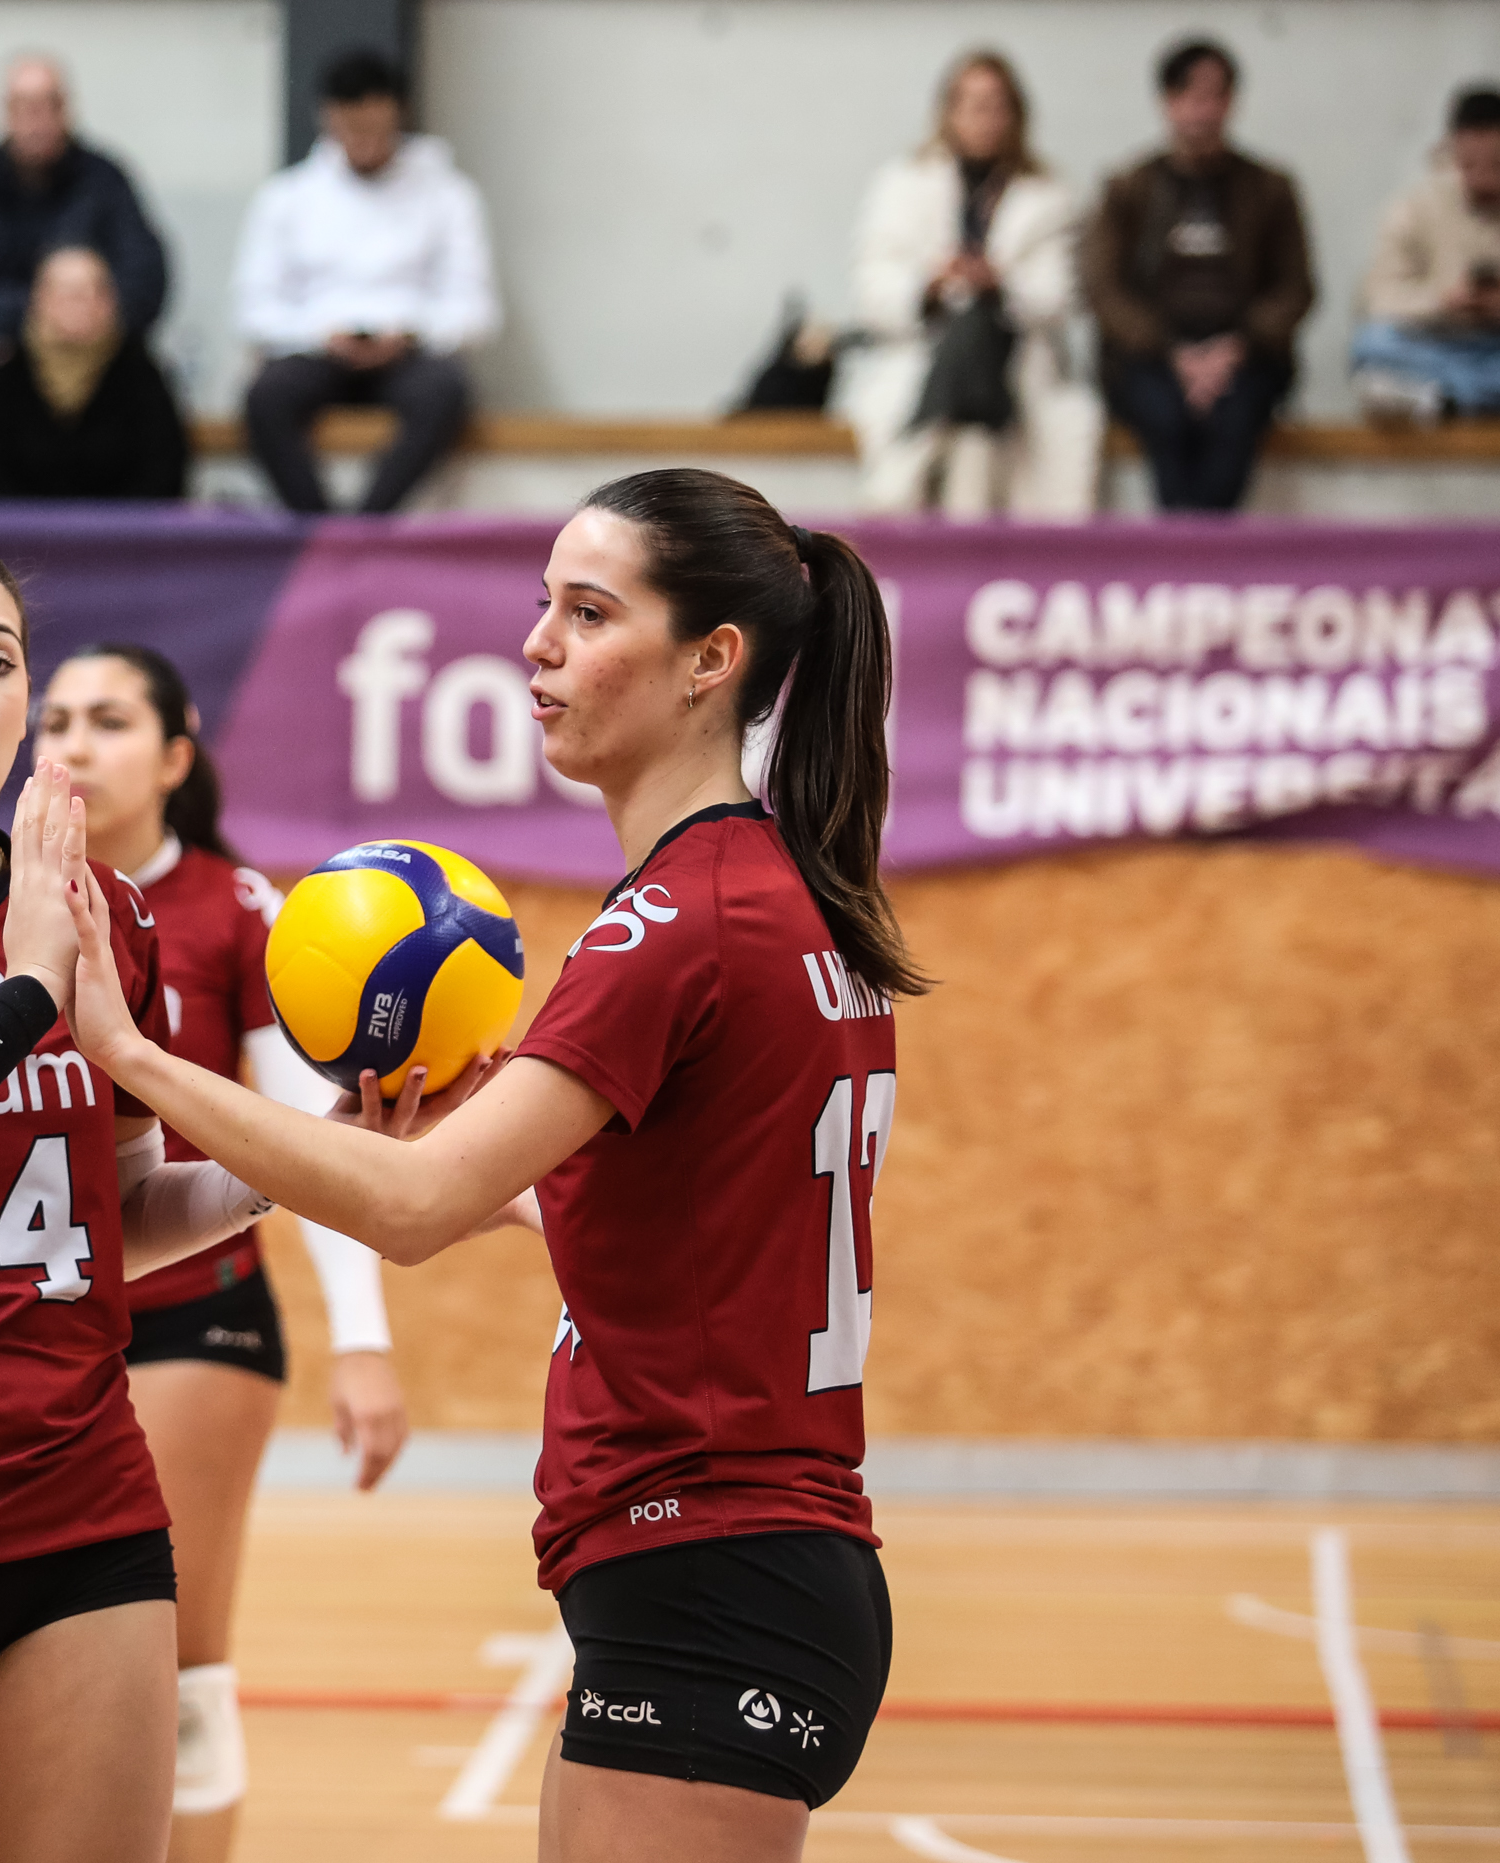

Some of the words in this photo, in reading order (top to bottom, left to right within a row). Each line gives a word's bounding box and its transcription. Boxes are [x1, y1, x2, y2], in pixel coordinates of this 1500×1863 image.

[964, 577, 1500, 672] CAMPEONA
[964, 666, 1486, 752] NACIONAIS
[367, 992, 393, 1039] FIVB
[392, 998, 408, 1041] APPROVED
[629, 1498, 681, 1526] POR
[607, 1700, 662, 1725] cdt
